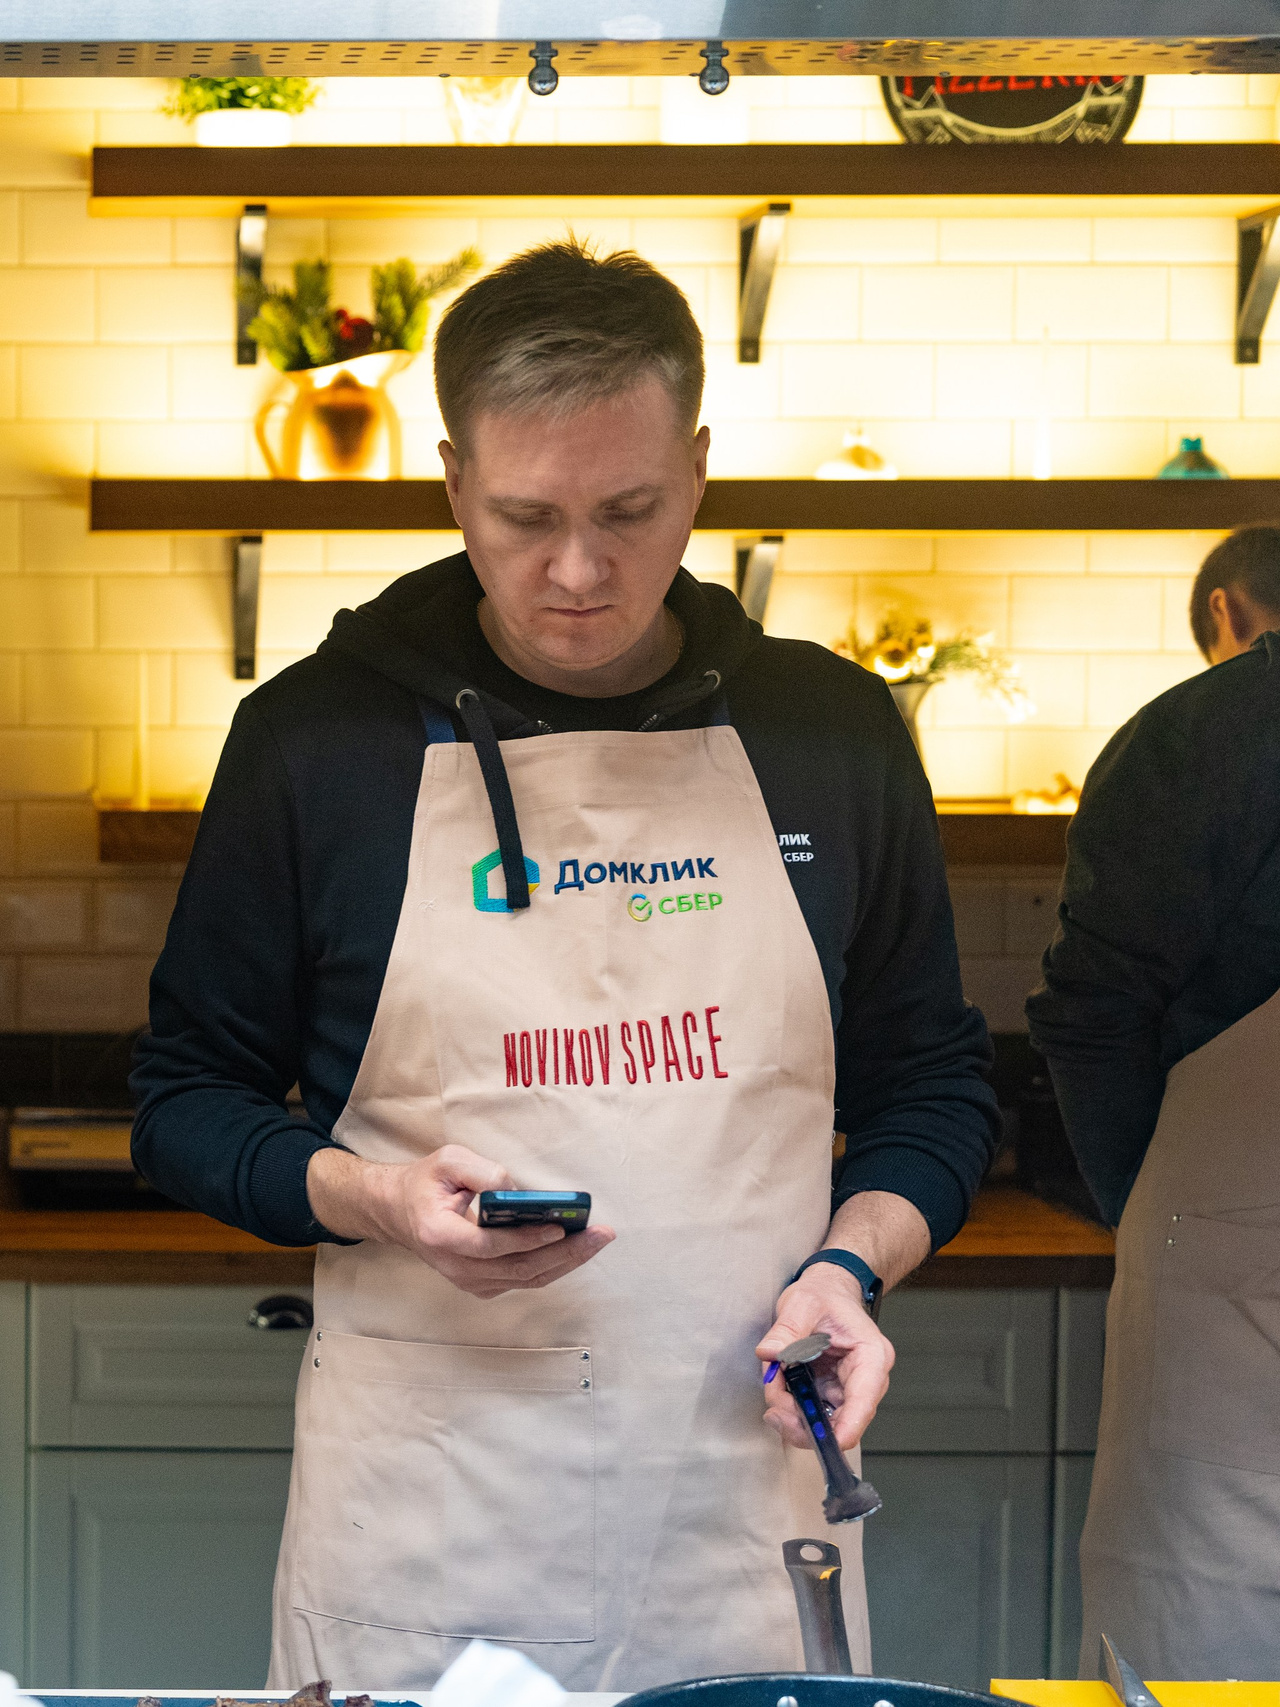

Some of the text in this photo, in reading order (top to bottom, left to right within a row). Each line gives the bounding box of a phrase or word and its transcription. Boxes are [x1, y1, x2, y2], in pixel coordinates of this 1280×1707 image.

[783, 852, 815, 863] СБЕР
[658, 892, 723, 915] СБЕР
[503, 1005, 728, 1088] NOVIKOV SPACE
